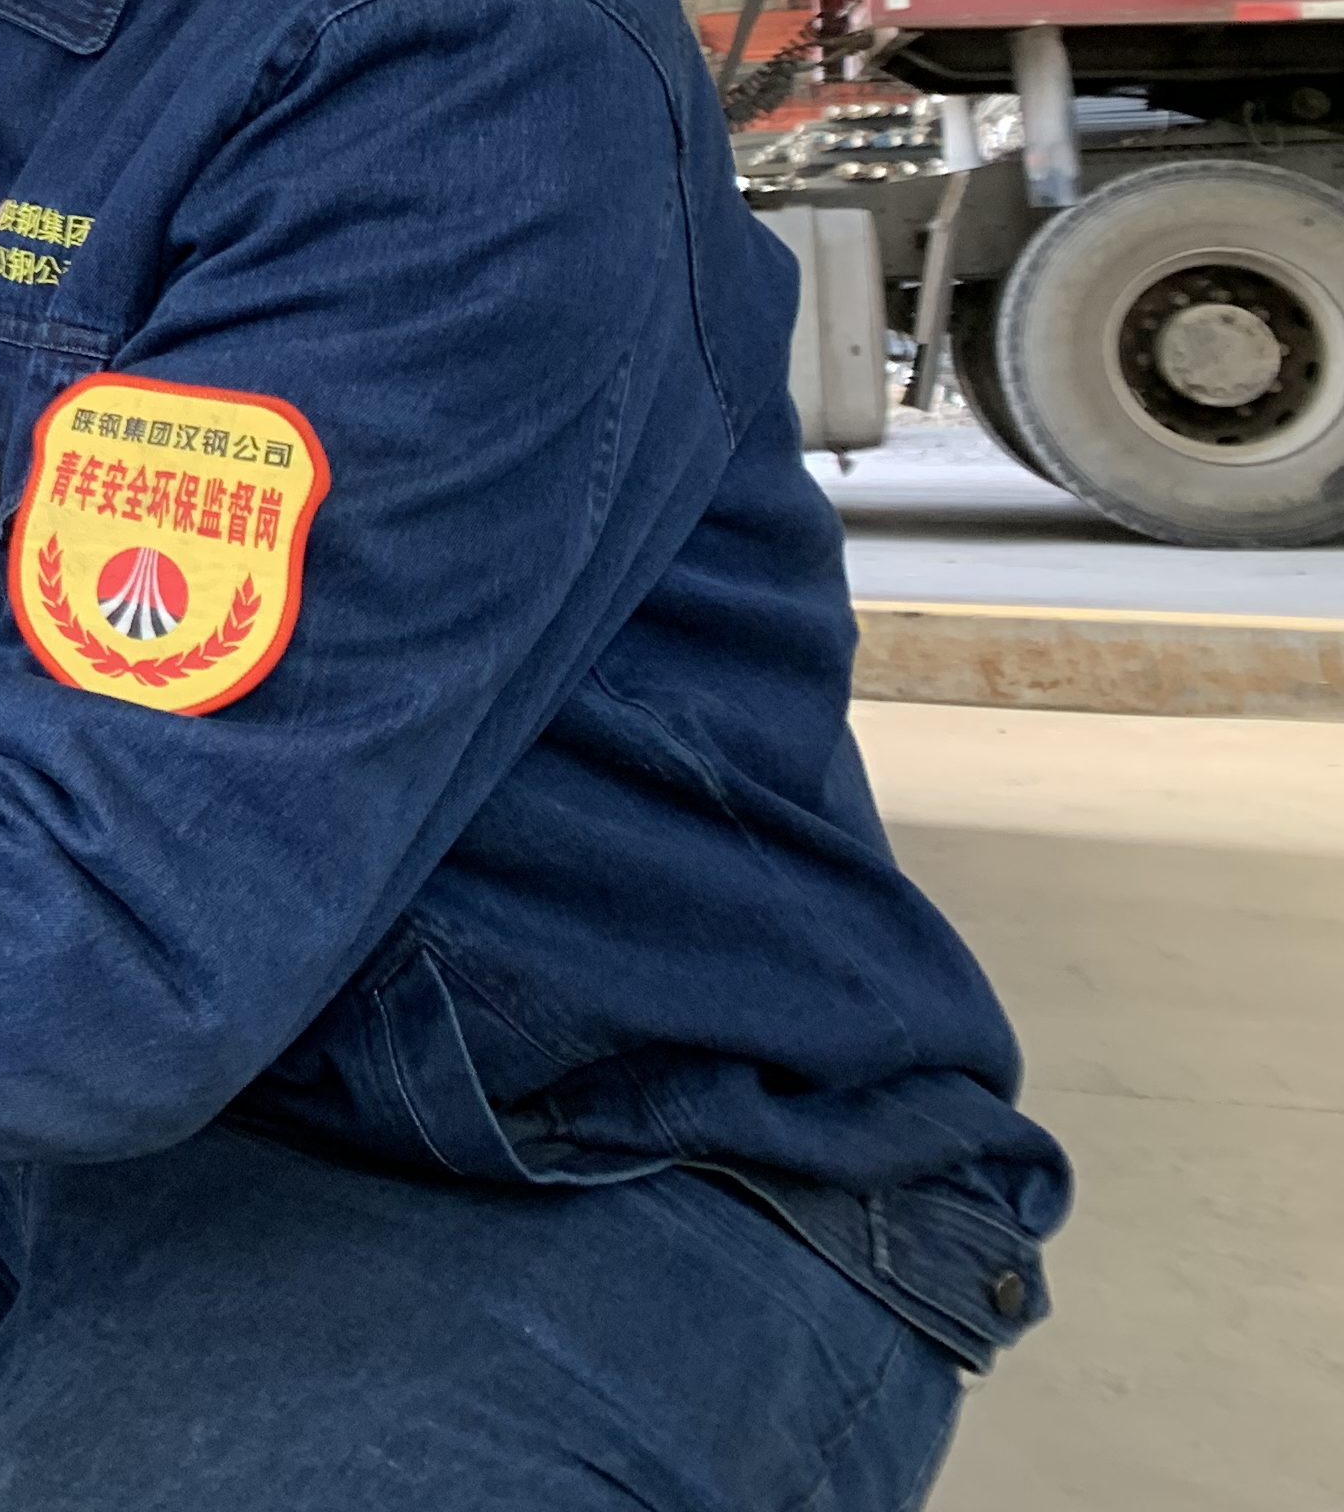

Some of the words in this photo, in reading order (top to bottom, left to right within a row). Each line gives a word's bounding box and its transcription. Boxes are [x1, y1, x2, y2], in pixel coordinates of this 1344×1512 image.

[71, 407, 295, 470] 陕钢集团汉钢公司
[49, 449, 284, 553] 青年安全环保监督岗
